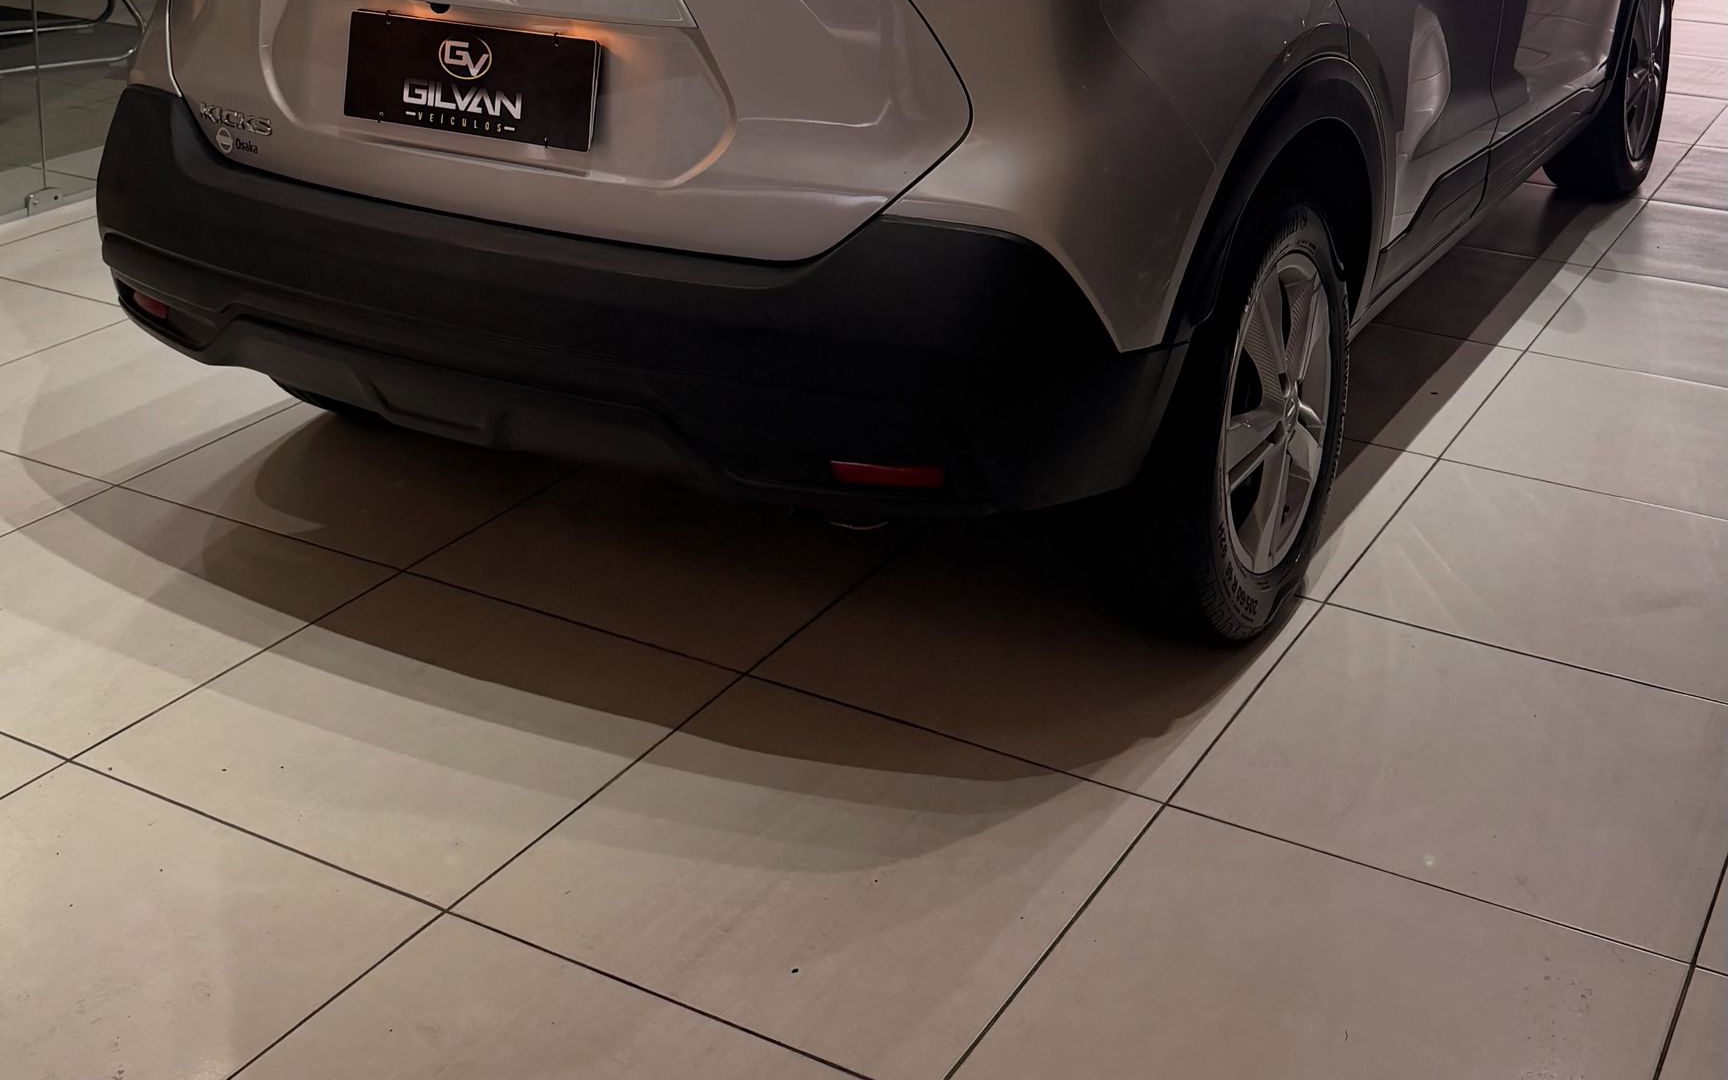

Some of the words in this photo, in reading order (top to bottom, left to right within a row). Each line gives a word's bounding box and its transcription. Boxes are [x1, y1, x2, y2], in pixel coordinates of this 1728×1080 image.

[444, 39, 489, 77] GV
[403, 78, 522, 120] GILVAN
[200, 102, 273, 136] KICKS
[417, 111, 502, 132] VEÍCULOS
[235, 138, 258, 154] Osaka
